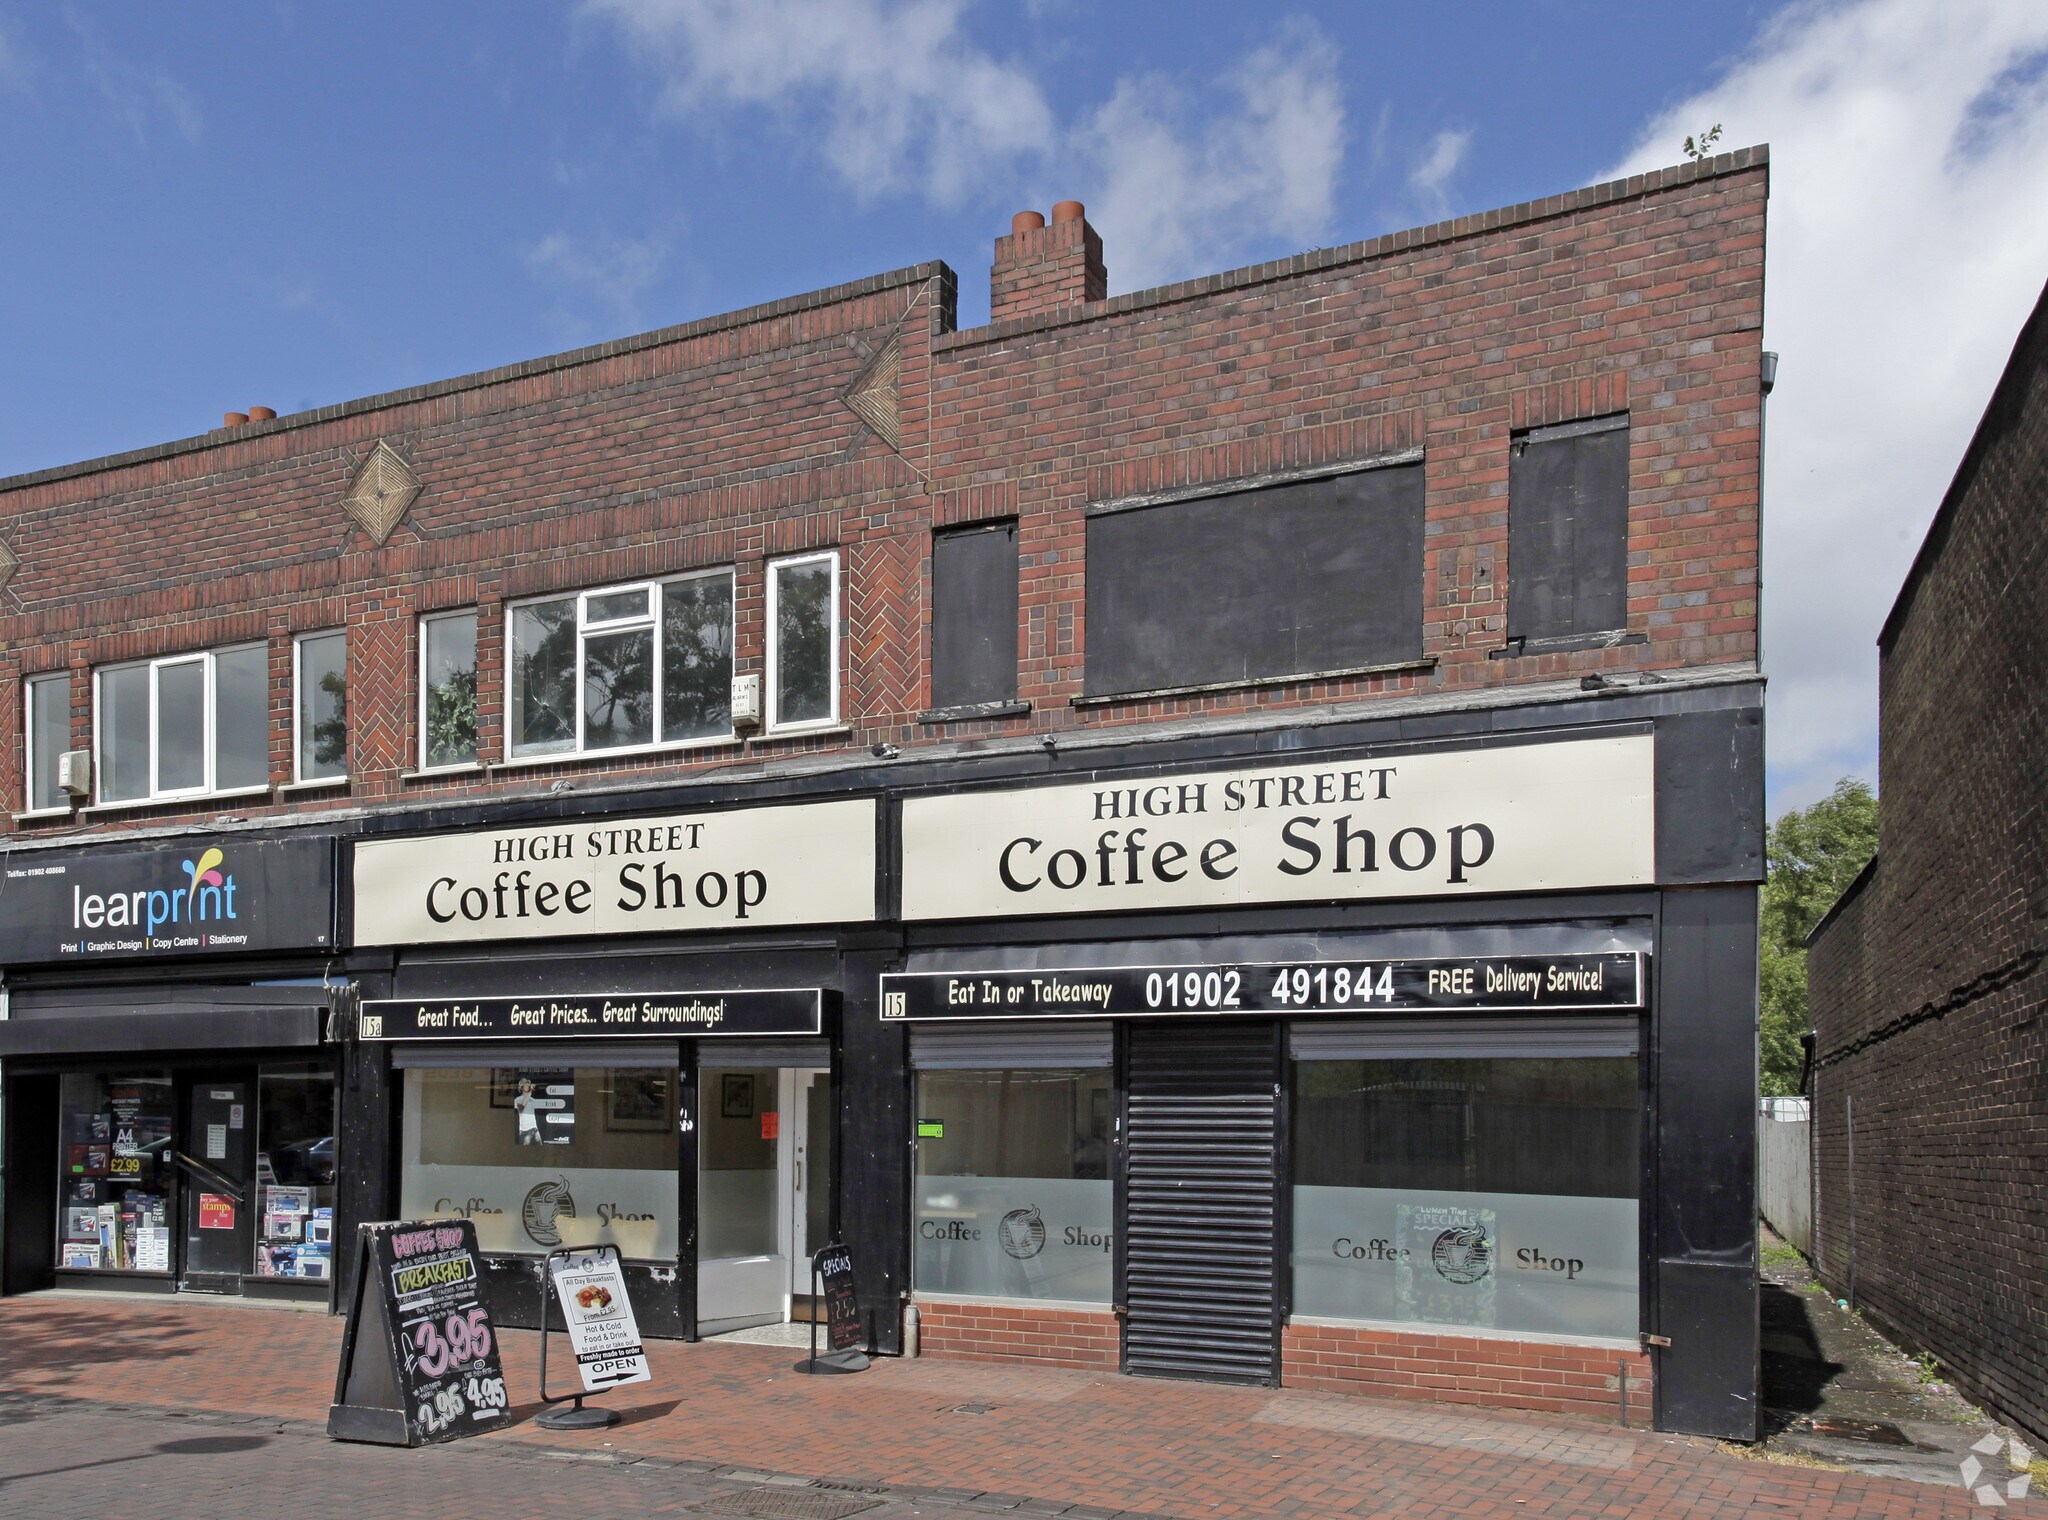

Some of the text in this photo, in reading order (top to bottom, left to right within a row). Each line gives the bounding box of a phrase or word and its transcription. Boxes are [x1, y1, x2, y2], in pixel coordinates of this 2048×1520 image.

[1092, 767, 1398, 821] HIGH STREET
[493, 823, 706, 864] HIGH STREET
[999, 814, 1496, 893] Coffee Shop
[28, 868, 44, 876] 01902
[74, 868, 237, 936] learprint
[426, 861, 768, 924] Coffee Shop
[61, 934, 247, 953] Print Graphic Design Copy Centre Stationery
[949, 962, 1603, 1009] Eat In or Takeaway 01902 491844 FREE Delivery Service!
[418, 998, 724, 1028] Great Food... Great Prices... Great Surroundings!
[887, 994, 904, 1016] 15
[363, 1017, 381, 1036] 15a
[116, 1128, 133, 1143] A4
[111, 1158, 140, 1173] £2.99
[203, 1202, 231, 1214] stamps
[1415, 1214, 1477, 1226] SPECIALS
[391, 1227, 464, 1259] COFFEE SHOP
[919, 1221, 1113, 1253] Coffee Shop
[823, 1255, 851, 1277] SPECIALS
[1332, 1238, 1584, 1280] Coffee Shop
[399, 1259, 468, 1293] BREAKFAST
[574, 1278, 585, 1286] Day
[586, 1275, 615, 1284] Breakfasts
[583, 1306, 616, 1321] From £2.95
[584, 1334, 602, 1343] Food
[609, 1330, 628, 1339] Drink
[585, 1324, 598, 1333] Hot
[606, 1322, 622, 1330] Cold
[580, 1352, 602, 1362] Freshly
[603, 1351, 618, 1359] made
[626, 1347, 640, 1355] order
[589, 1344, 598, 1352] eat
[592, 1358, 637, 1373] OPEN
